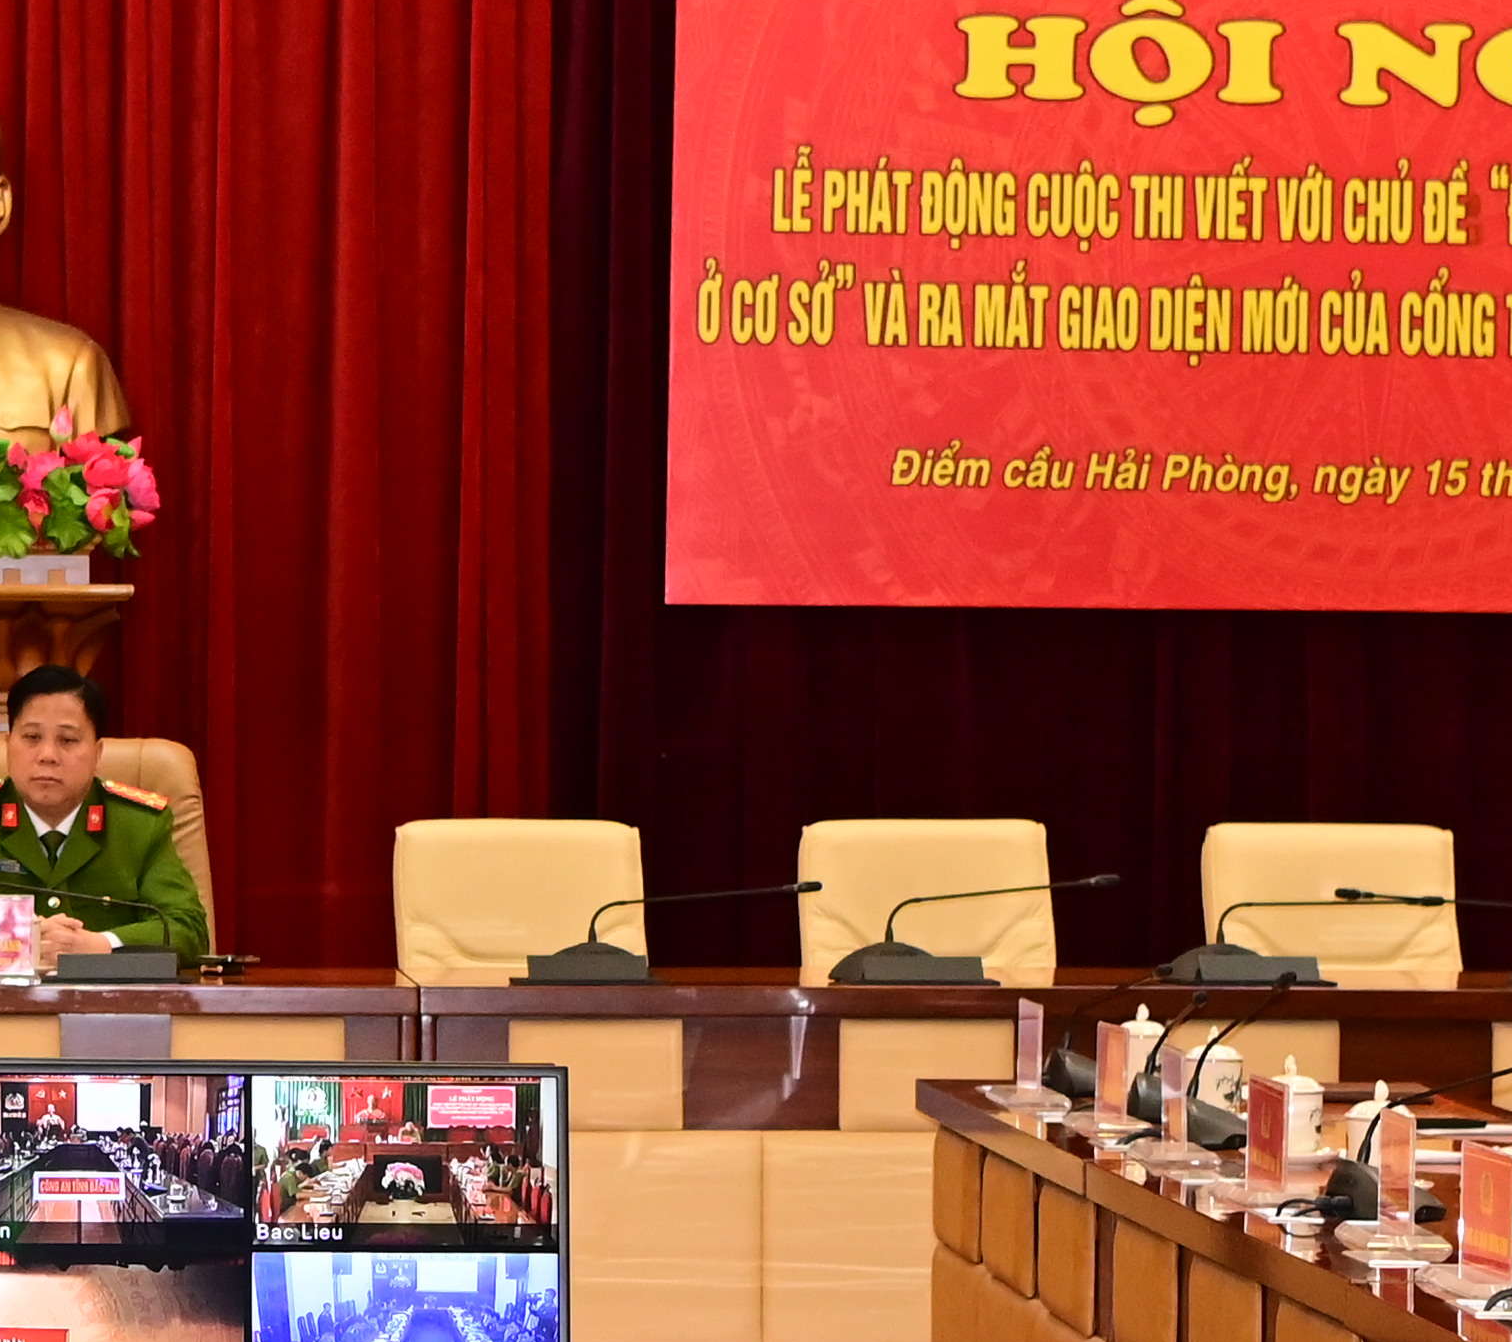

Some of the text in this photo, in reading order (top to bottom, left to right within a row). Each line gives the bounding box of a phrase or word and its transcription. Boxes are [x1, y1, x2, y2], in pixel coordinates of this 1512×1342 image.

[773, 145, 813, 232] LỄ
[823, 156, 912, 234] PHÁT
[920, 157, 1016, 245] ĐỘNG
[1027, 160, 1120, 248] CUỘC
[1130, 174, 1184, 239] THI
[1194, 156, 1268, 241] VIẾT
[1277, 164, 1333, 242] VỚI
[1343, 158, 1413, 244] CHỦ
[1423, 160, 1468, 244] ĐỀ
[698, 257, 723, 344] Ở
[731, 274, 779, 345] CƠ
[864, 269, 908, 346] VÀ
[918, 283, 963, 347] RA
[974, 260, 1049, 348] MẮT
[1058, 285, 1139, 351] GIAO
[1150, 274, 1231, 365] DIỆN
[1242, 276, 1309, 354] MỚI
[1320, 269, 1389, 355] CỦA
[1400, 270, 1495, 357] CỔNG
[892, 439, 991, 487] Điểm
[1003, 446, 1075, 489] cầu
[1085, 448, 1152, 490] Hải
[1162, 454, 1298, 502] Phòng,
[1313, 456, 1411, 504] ngày
[1427, 459, 1469, 496] 15
[256, 1223, 343, 1241] Bac Lieu
